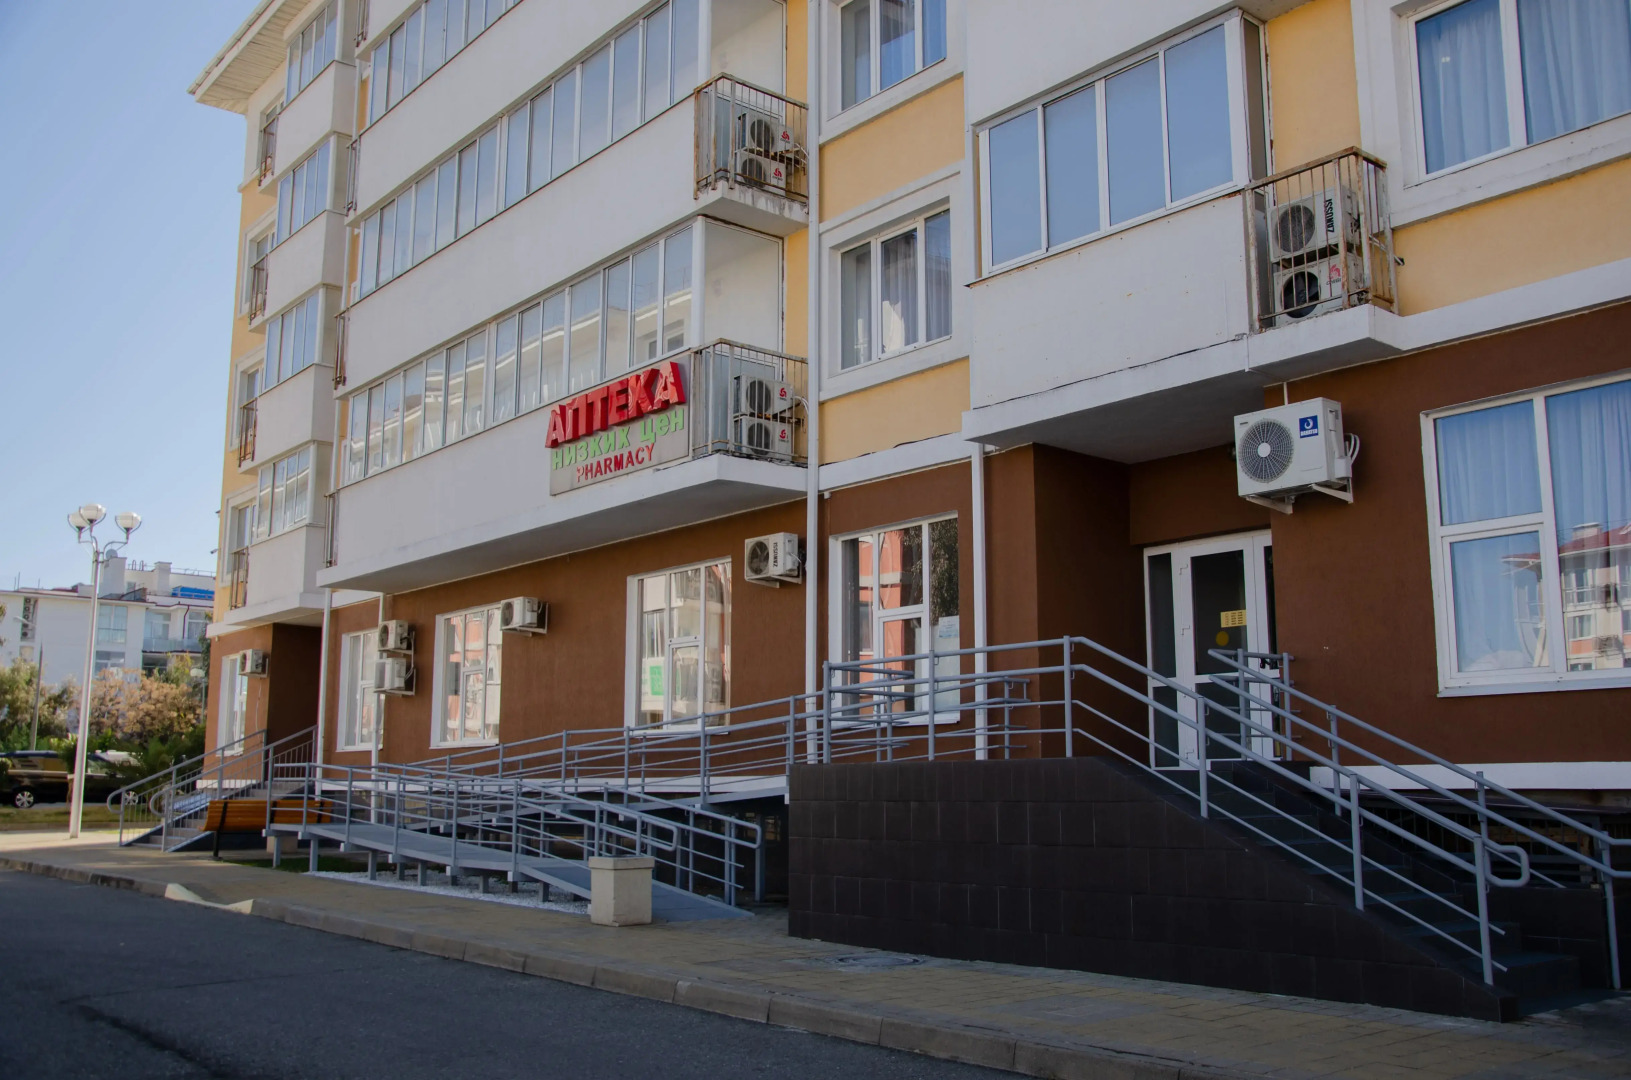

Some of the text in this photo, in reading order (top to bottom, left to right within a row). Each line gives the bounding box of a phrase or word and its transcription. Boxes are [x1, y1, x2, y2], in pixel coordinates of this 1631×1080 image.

[1325, 198, 1335, 233] ZANUSSI
[544, 361, 687, 449] АПТЕКА
[639, 408, 685, 444] цен
[576, 442, 655, 483] PHARMACY
